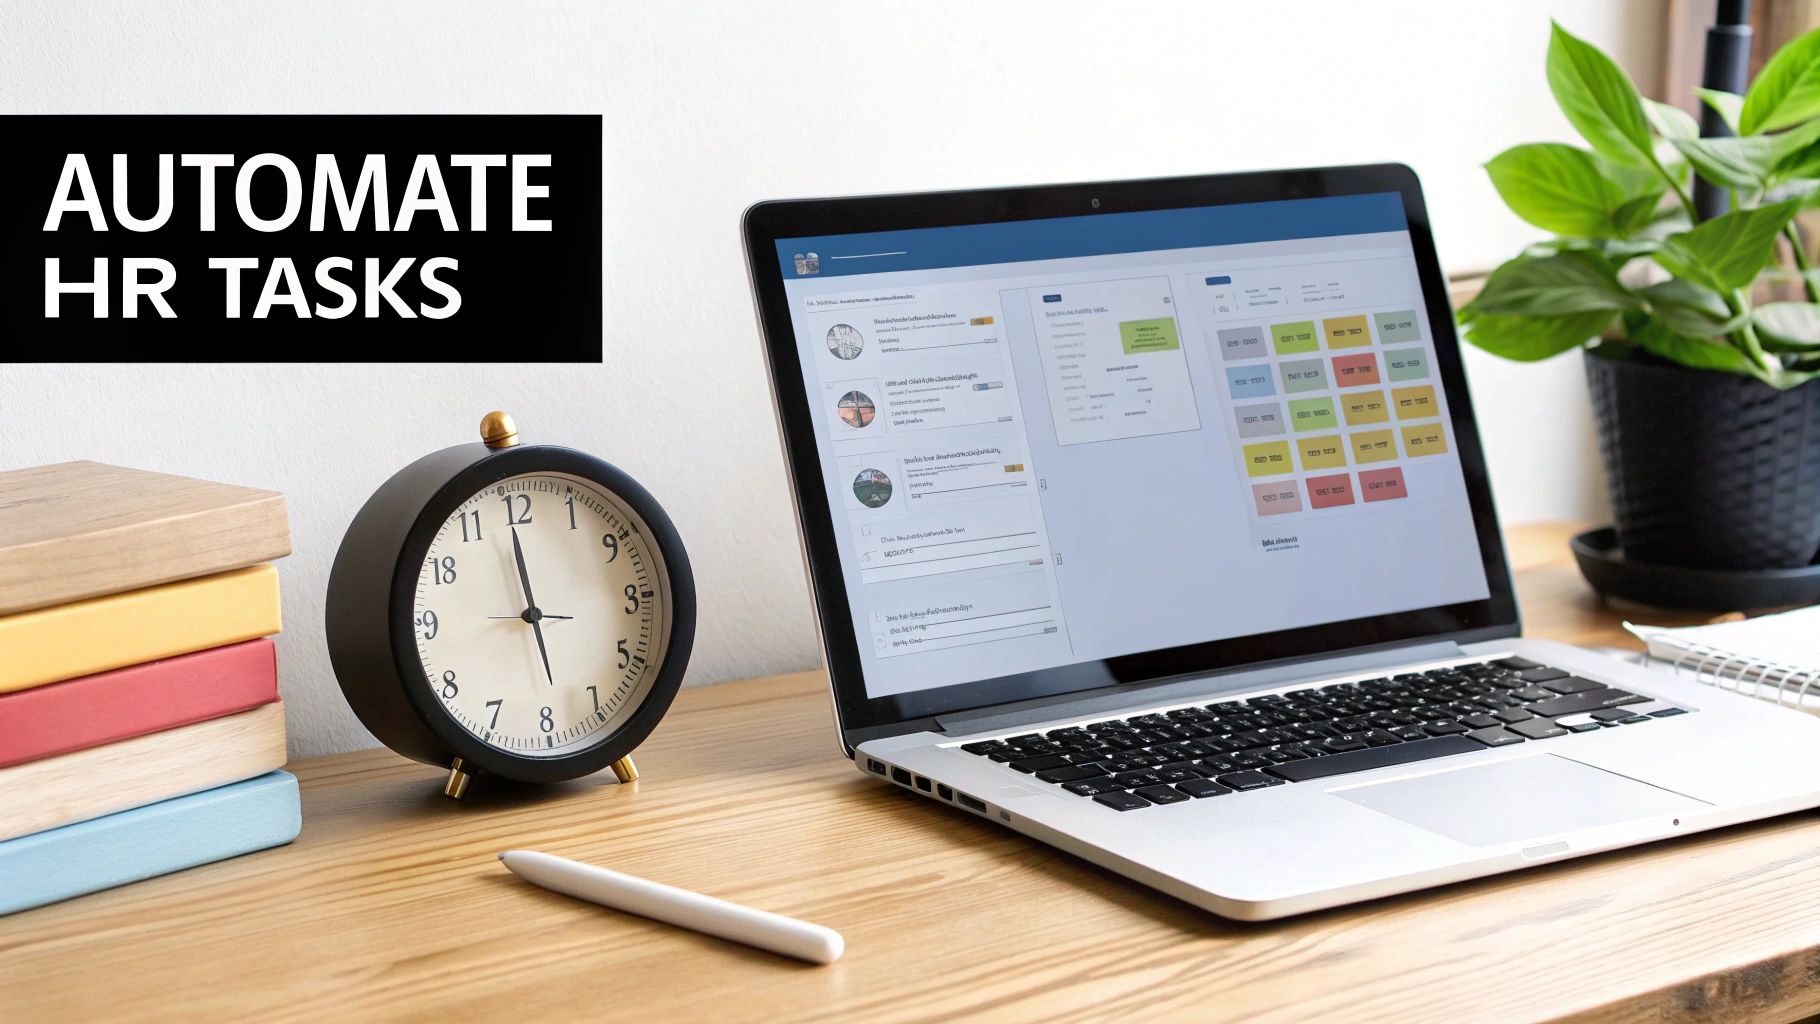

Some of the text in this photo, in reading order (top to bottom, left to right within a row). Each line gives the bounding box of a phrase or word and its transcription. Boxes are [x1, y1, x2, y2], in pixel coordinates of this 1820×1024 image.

[501, 494, 533, 526] 12
[565, 496, 577, 530] 1
[459, 510, 484, 543] 11
[602, 533, 618, 563] 9
[432, 556, 457, 586] 18
[624, 584, 639, 615] 3
[422, 610, 439, 640] 9
[616, 638, 630, 670] 5
[441, 670, 459, 699] 8
[485, 700, 503, 729] 7
[539, 706, 554, 732] 8
